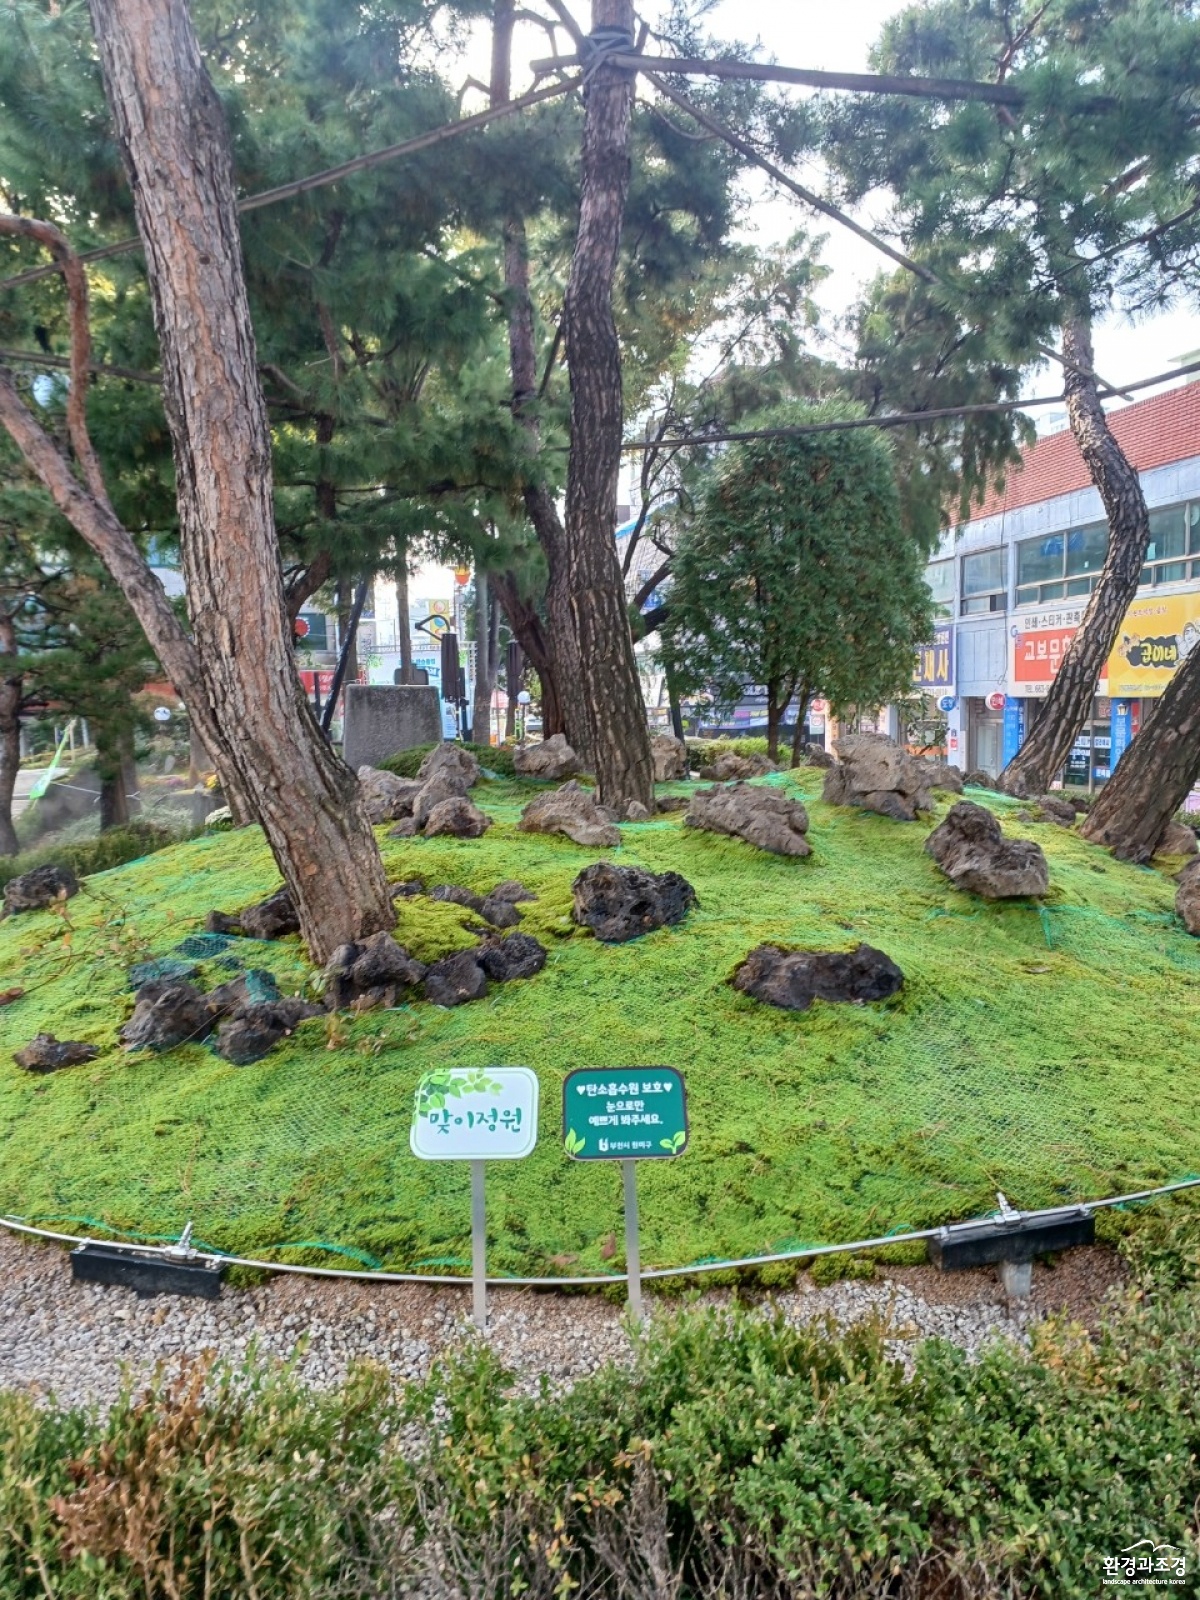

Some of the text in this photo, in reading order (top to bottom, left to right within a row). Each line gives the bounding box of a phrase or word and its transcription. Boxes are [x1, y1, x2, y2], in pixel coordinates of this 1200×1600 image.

[586, 1081, 664, 1097] 탄소흡수원 보호
[606, 1100, 645, 1113] 눈으로만
[429, 1107, 523, 1135] 맞이정원
